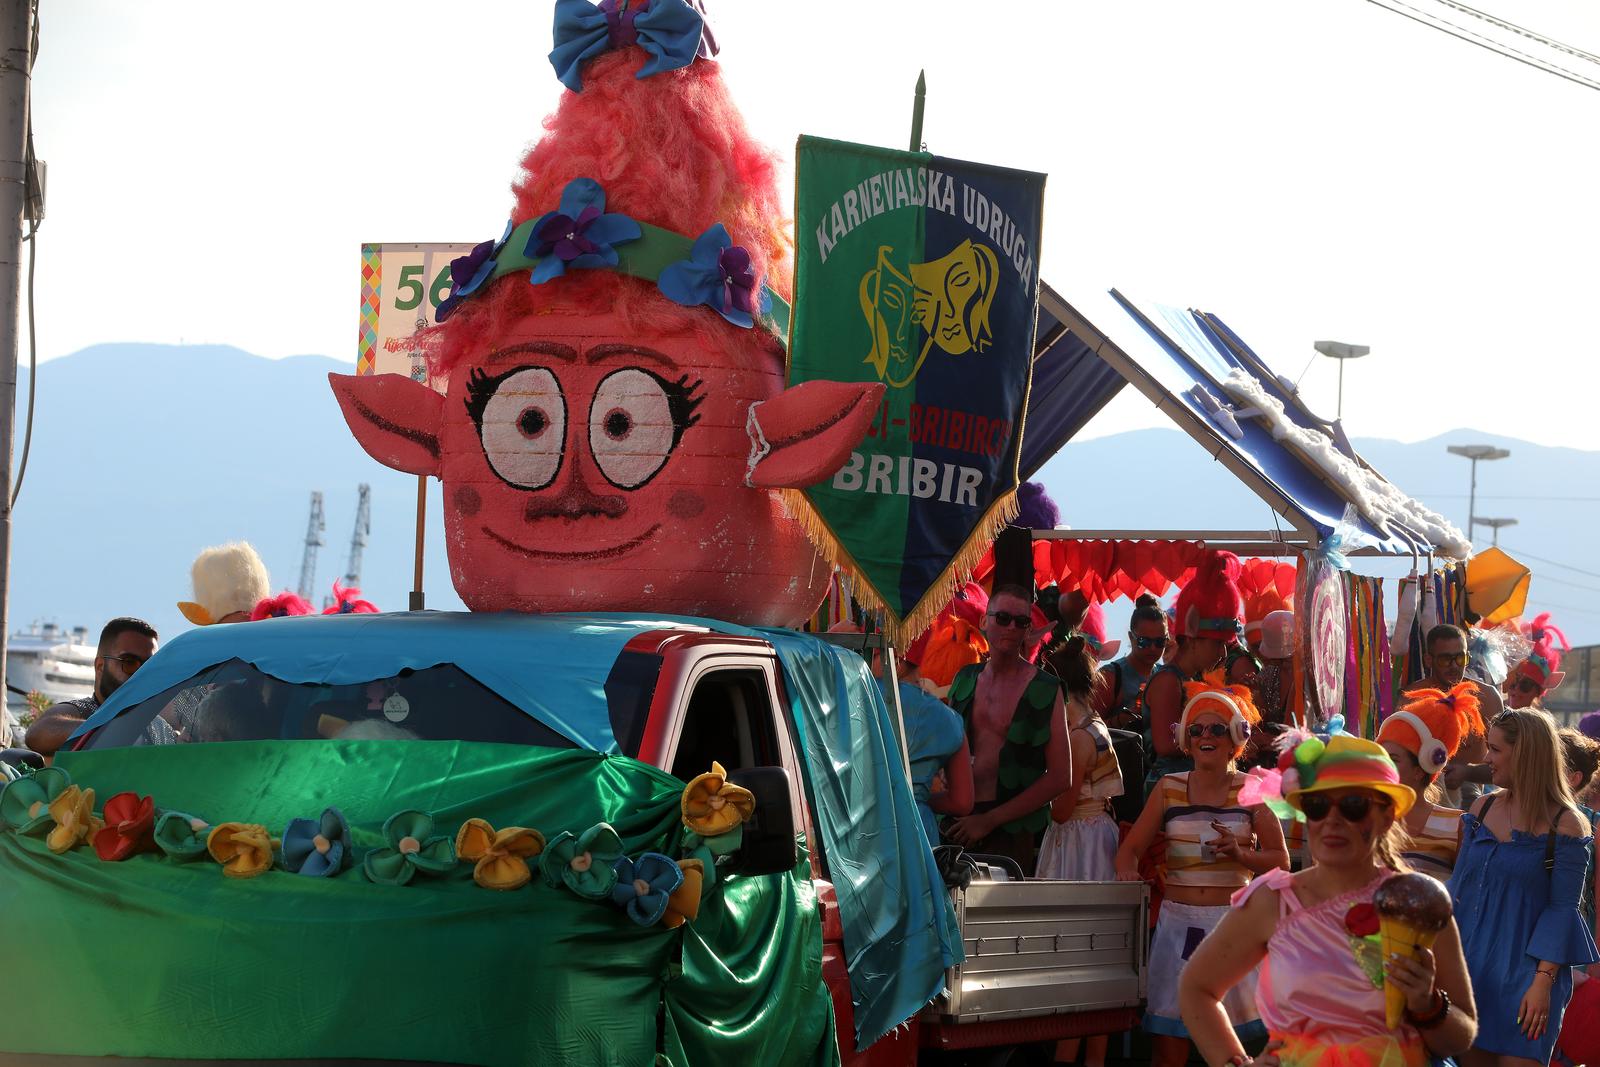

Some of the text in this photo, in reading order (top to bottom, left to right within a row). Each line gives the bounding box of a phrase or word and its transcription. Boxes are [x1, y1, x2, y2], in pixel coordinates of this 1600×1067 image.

[816, 167, 1032, 297] KARNEVALSKA UDRUGA
[395, 265, 454, 311] 56
[832, 451, 983, 507] BRIBIR
